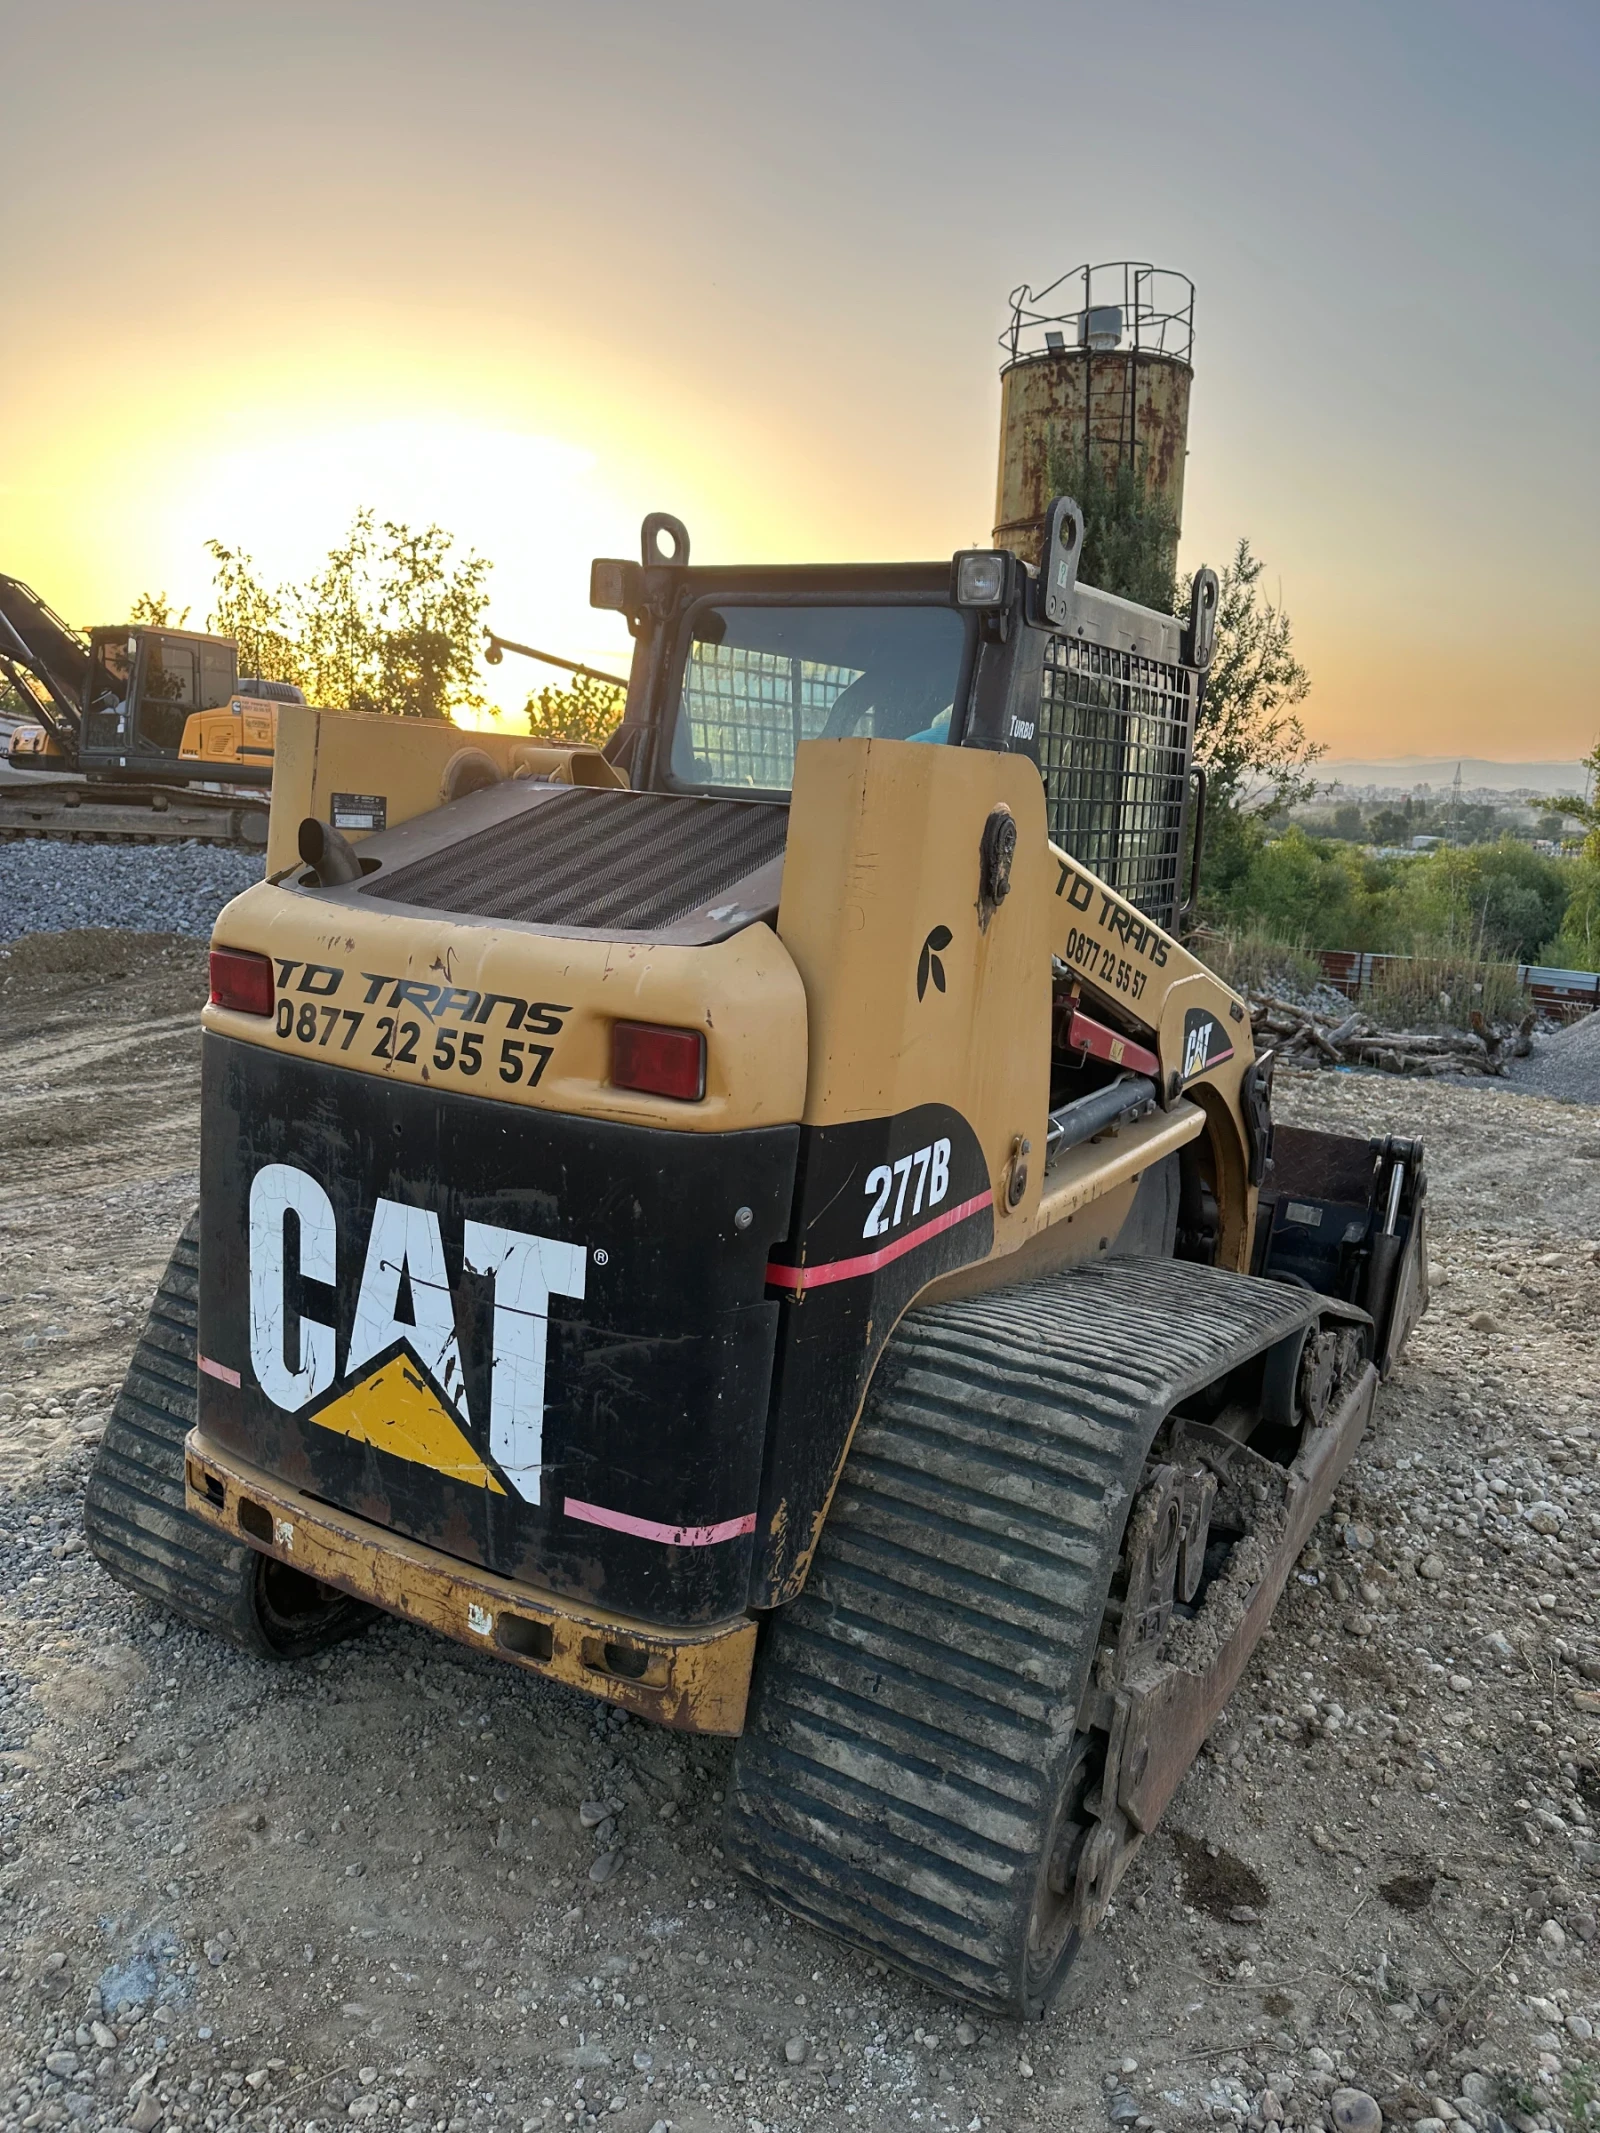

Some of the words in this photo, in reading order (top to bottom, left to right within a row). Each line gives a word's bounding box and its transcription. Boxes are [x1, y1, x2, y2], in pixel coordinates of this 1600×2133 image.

[1055, 857, 1094, 912] TD
[1098, 891, 1172, 968] TRANS
[274, 958, 344, 996] TD
[360, 972, 574, 1036] TRANS
[1066, 927, 1101, 972] 0877
[1098, 949, 1116, 983] 22
[1115, 959, 1132, 992] 55
[1131, 969, 1148, 1000] 57
[276, 998, 365, 1051] 0877
[371, 1016, 421, 1064] 22
[432, 1027, 485, 1076] 55
[499, 1039, 555, 1088] 57
[1184, 1022, 1214, 1079] CAT
[862, 1137, 951, 1239] 277B
[249, 1163, 587, 1506] CAT
